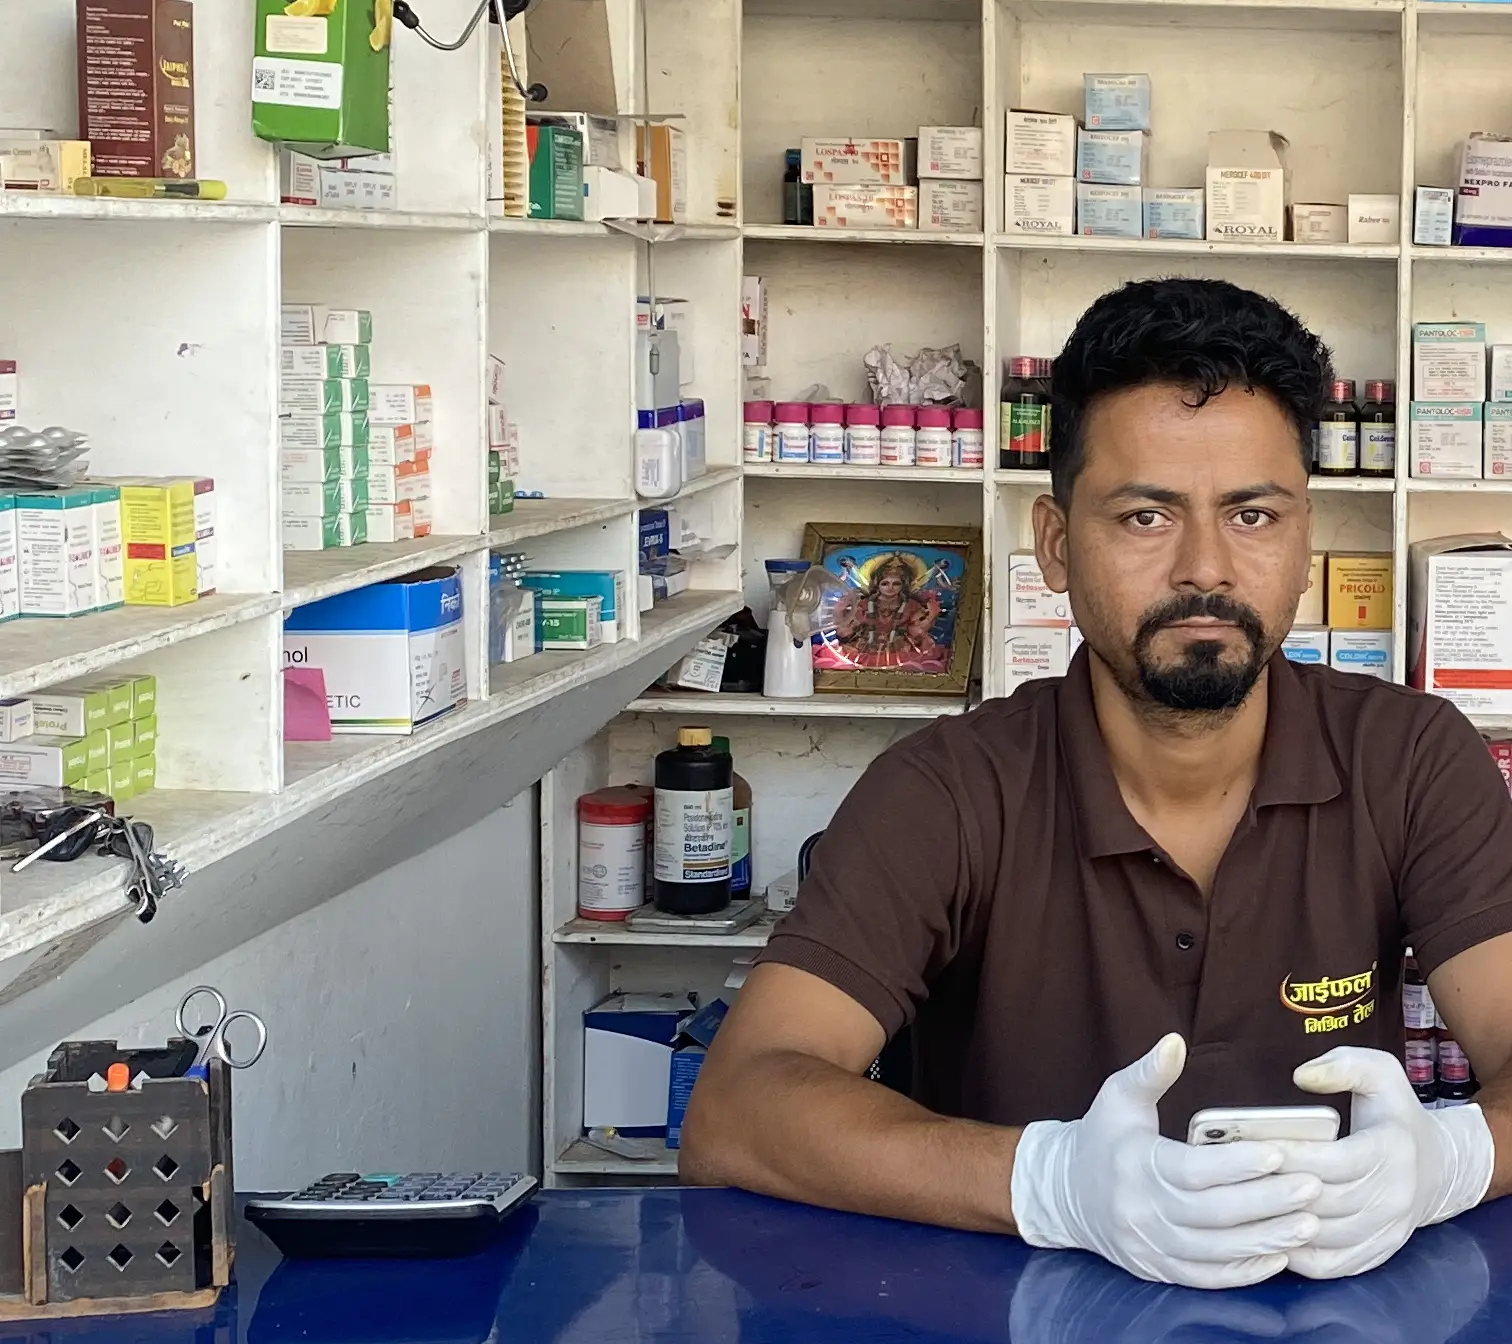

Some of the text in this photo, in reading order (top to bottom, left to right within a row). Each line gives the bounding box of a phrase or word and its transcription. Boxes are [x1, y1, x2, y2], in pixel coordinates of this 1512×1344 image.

[1223, 225, 1277, 235] ROYAL
[684, 841, 726, 853] Betadine
[1289, 971, 1372, 1004] जाईफल
[1353, 998, 1376, 1024] तेल
